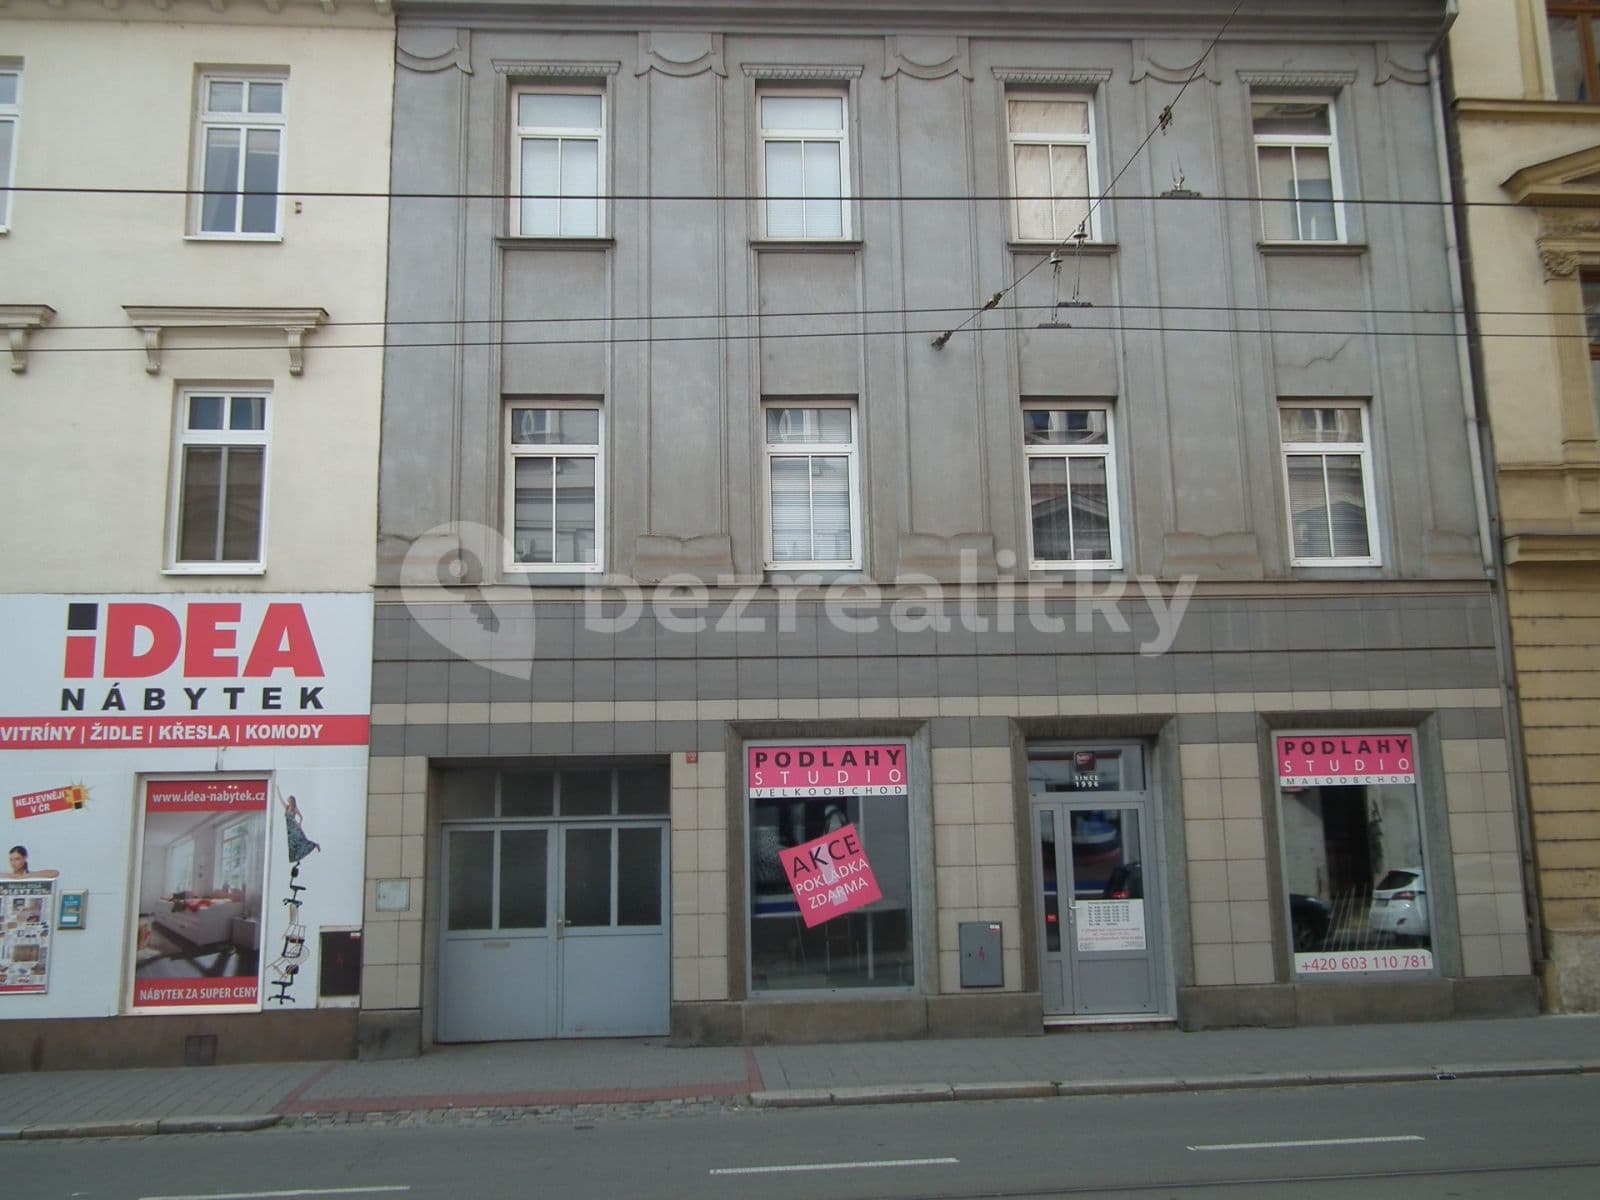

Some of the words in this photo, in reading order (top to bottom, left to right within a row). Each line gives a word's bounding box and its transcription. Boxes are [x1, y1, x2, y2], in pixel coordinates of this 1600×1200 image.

[60, 683, 324, 711] NÁBYTEK
[0, 722, 76, 741] VITRÍNY
[90, 723, 143, 740] ŽIDLE
[158, 722, 230, 740] KŘESLA
[245, 724, 323, 739] KOMODY
[1284, 740, 1408, 755] PODLAHY
[755, 750, 900, 768] PODLAHY
[1284, 758, 1409, 773] STUDIO
[754, 769, 901, 785] STUDIO
[1286, 776, 1411, 785] MALOOBCHOD
[152, 790, 266, 804] www.idea-nabytek.cz
[755, 786, 902, 797] VELKOOBCHOD
[793, 834, 859, 878] AKCE
[808, 877, 869, 909] ZDARMA
[1302, 958, 1337, 971] +420
[1341, 957, 1367, 970] 603
[1373, 956, 1398, 969] 110
[1404, 955, 1427, 968] 781
[139, 988, 184, 1001] NÁBYTEK
[185, 988, 198, 999] ZA
[200, 987, 231, 999] SUPER
[233, 986, 258, 998] CENY
